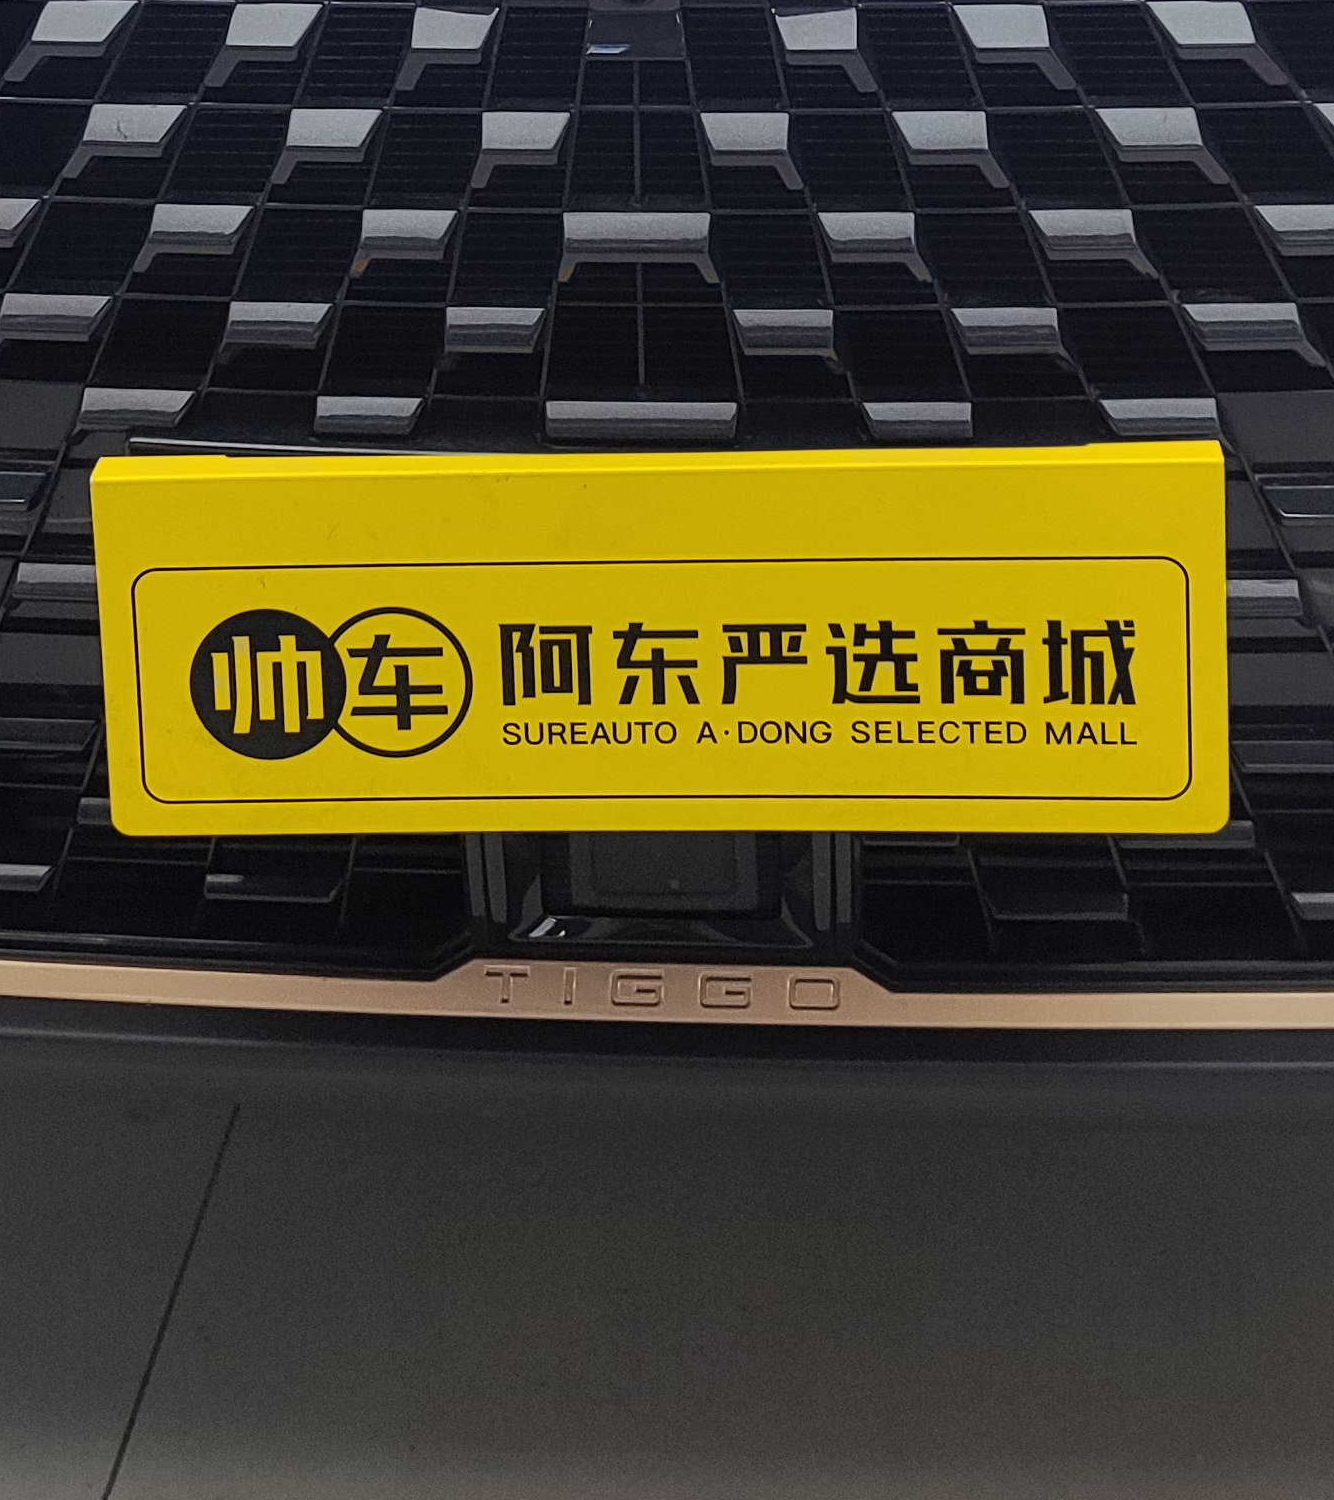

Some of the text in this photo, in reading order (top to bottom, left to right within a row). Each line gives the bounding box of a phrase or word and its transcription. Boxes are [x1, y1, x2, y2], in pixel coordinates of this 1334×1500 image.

[211, 634, 448, 734] 帅车
[498, 619, 1137, 706] 阿东严选商城
[502, 721, 677, 746] SUREAUTO
[850, 720, 1027, 745] SELECTED
[1045, 721, 1138, 746] MALL
[484, 965, 840, 1011] TIGGO
